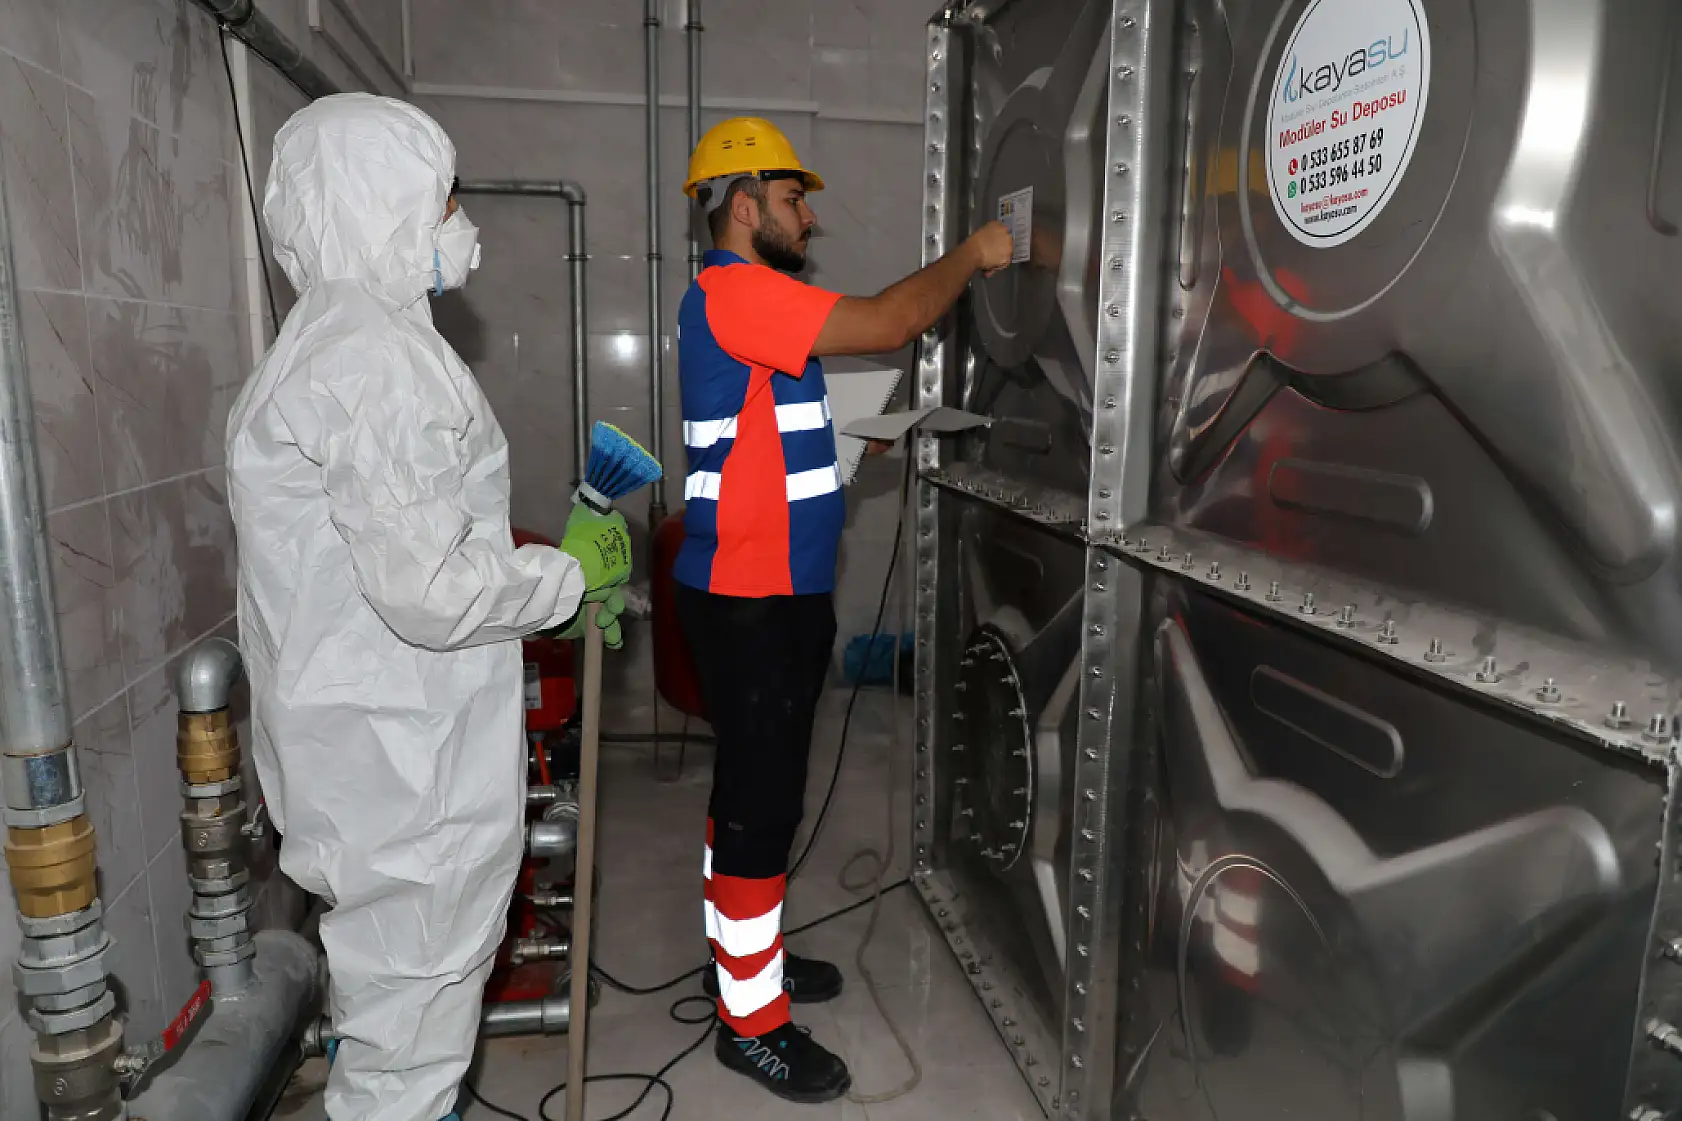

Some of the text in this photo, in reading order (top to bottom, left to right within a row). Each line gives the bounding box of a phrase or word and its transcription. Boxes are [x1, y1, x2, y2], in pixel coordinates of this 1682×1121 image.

[1299, 28, 1408, 99] kayasu
[1279, 89, 1407, 149] Modüler Su Deposu
[1301, 127, 1383, 172] 0 533 655 87 69
[1301, 153, 1382, 194] 0 533 596 44 50
